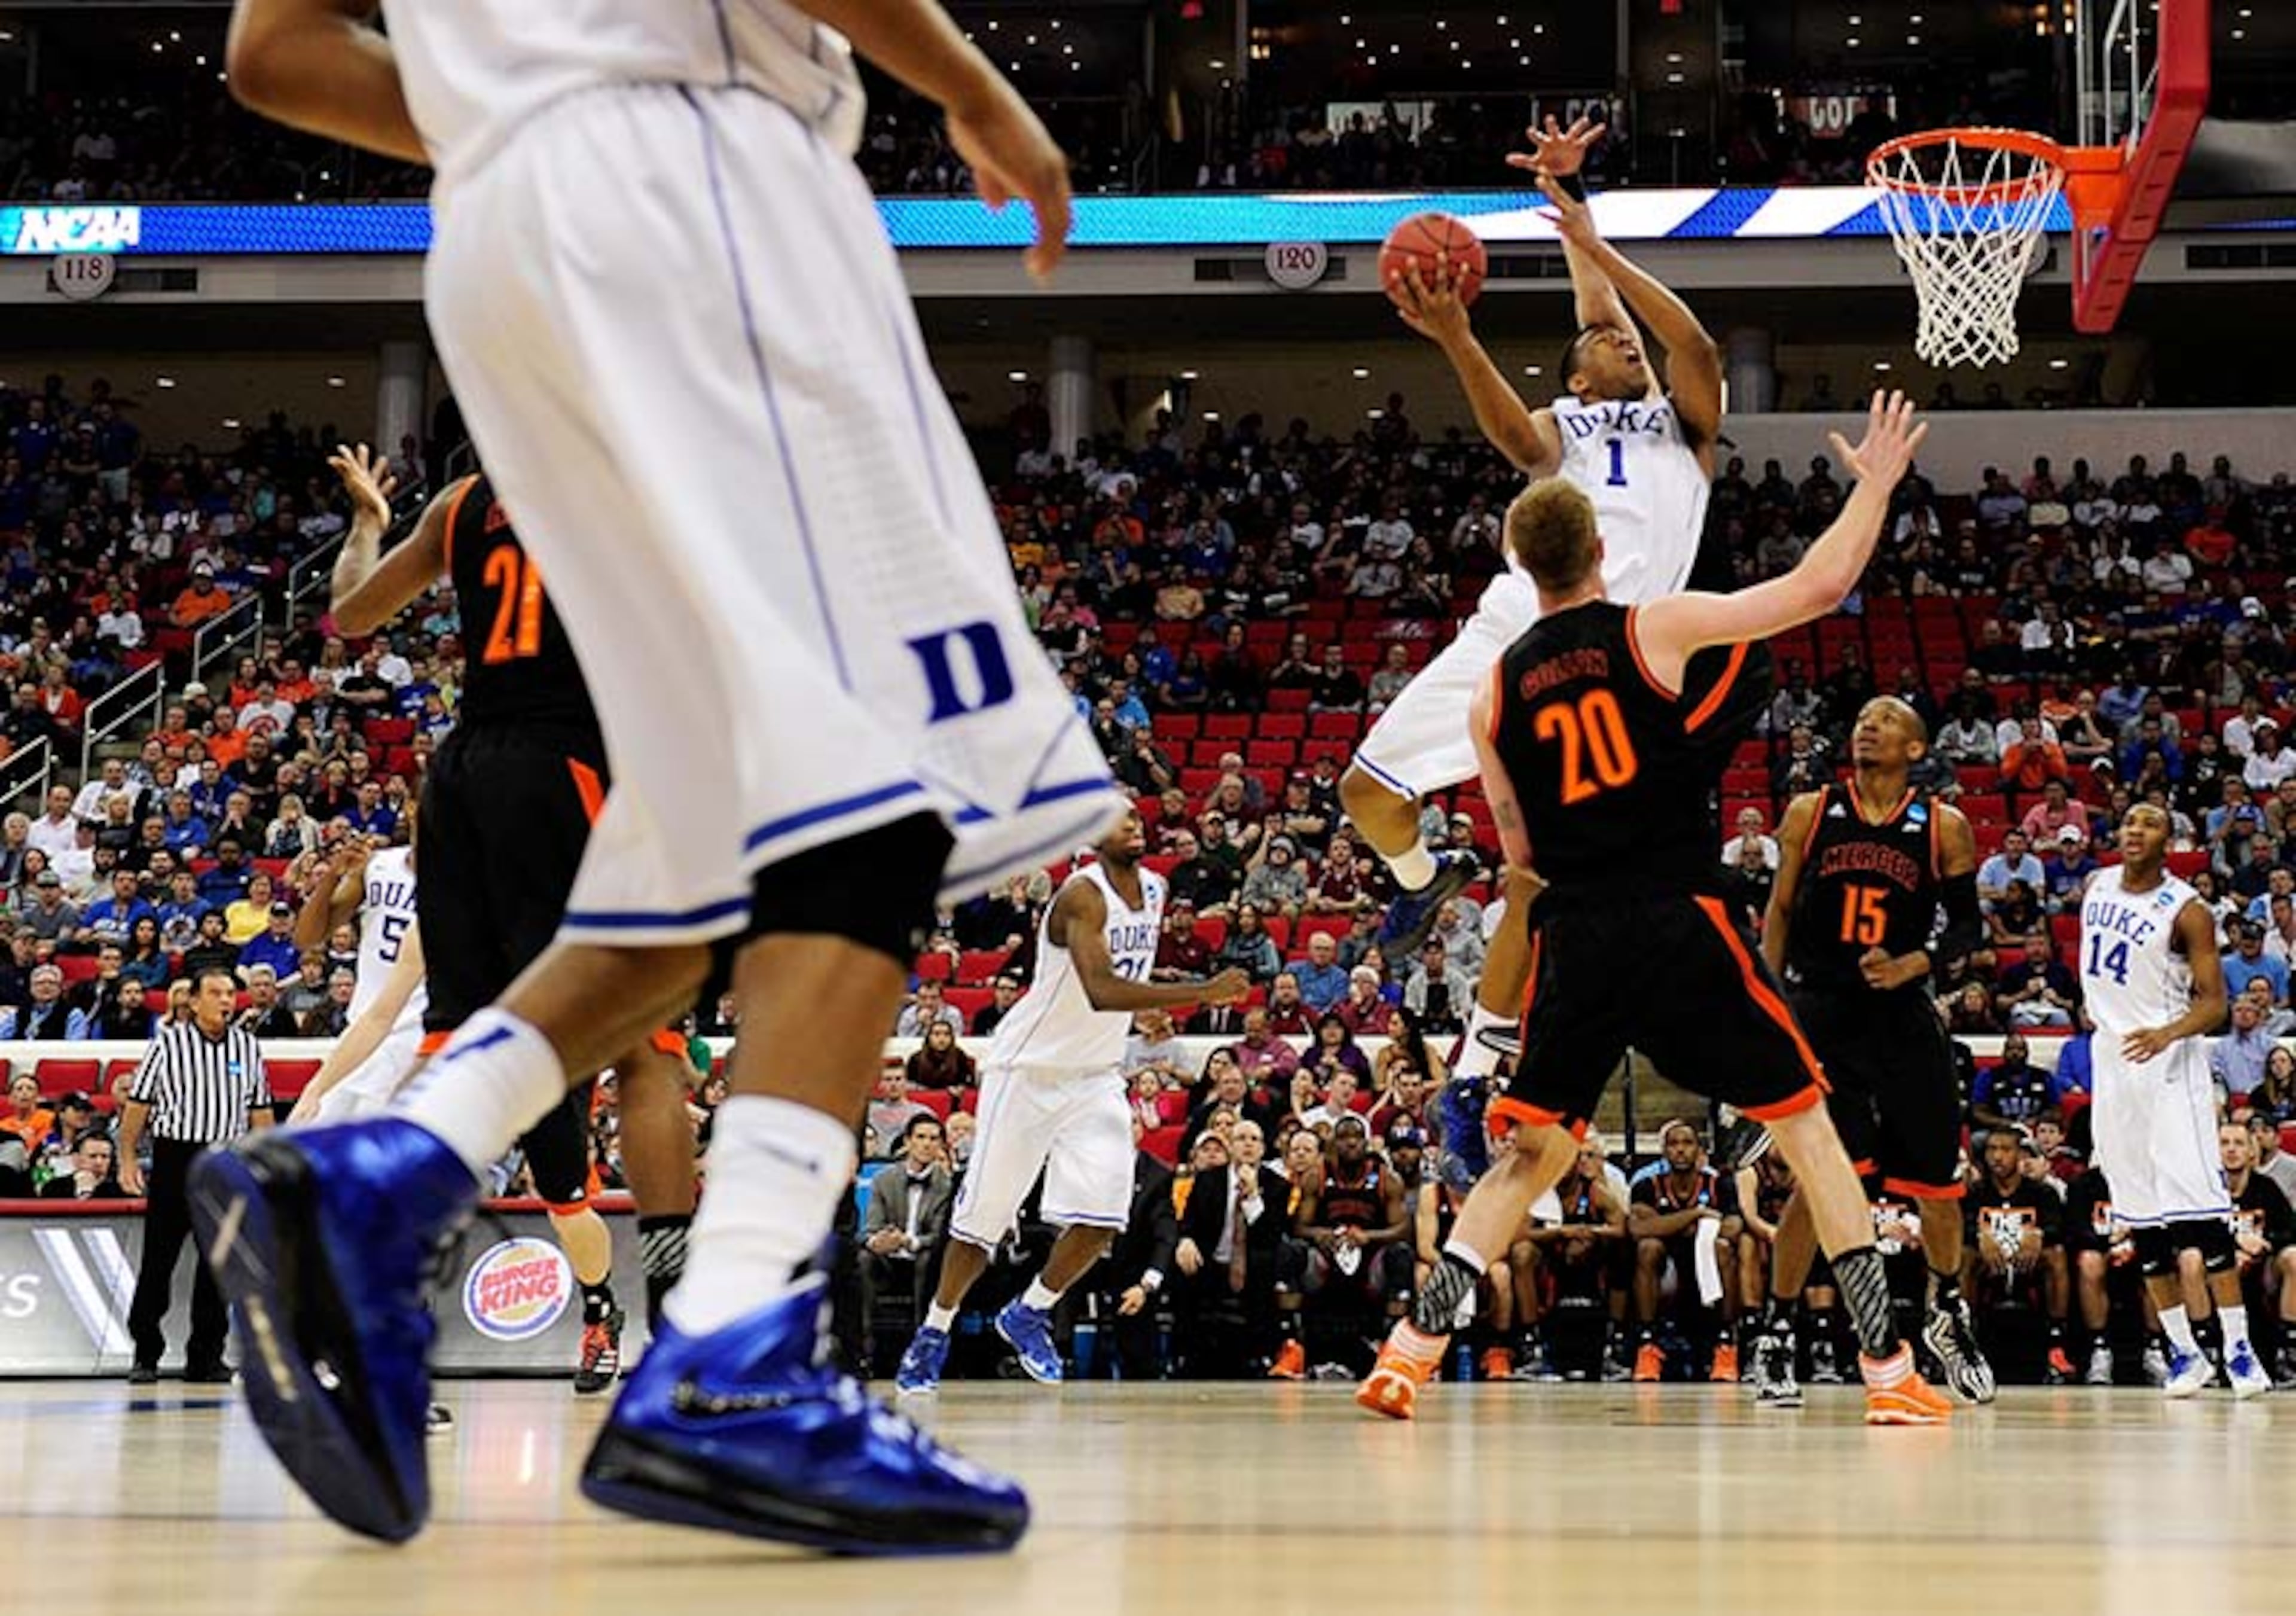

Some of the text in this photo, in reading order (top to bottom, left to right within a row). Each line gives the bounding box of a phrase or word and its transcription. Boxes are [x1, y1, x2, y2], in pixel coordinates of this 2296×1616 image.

[15, 206, 141, 252] NCAA
[65, 258, 102, 279] 118
[1275, 246, 1315, 270] 120
[1561, 401, 1672, 438] DUKE
[1605, 438, 1628, 487] 1
[904, 621, 1013, 724] D
[1534, 688, 1638, 805] 20
[1840, 883, 1890, 946] 15
[2086, 901, 2155, 946] DUKE
[378, 914, 410, 963] 5
[2087, 932, 2129, 986] 14
[480, 1257, 559, 1295] BURGER
[481, 1274, 559, 1314] KING
